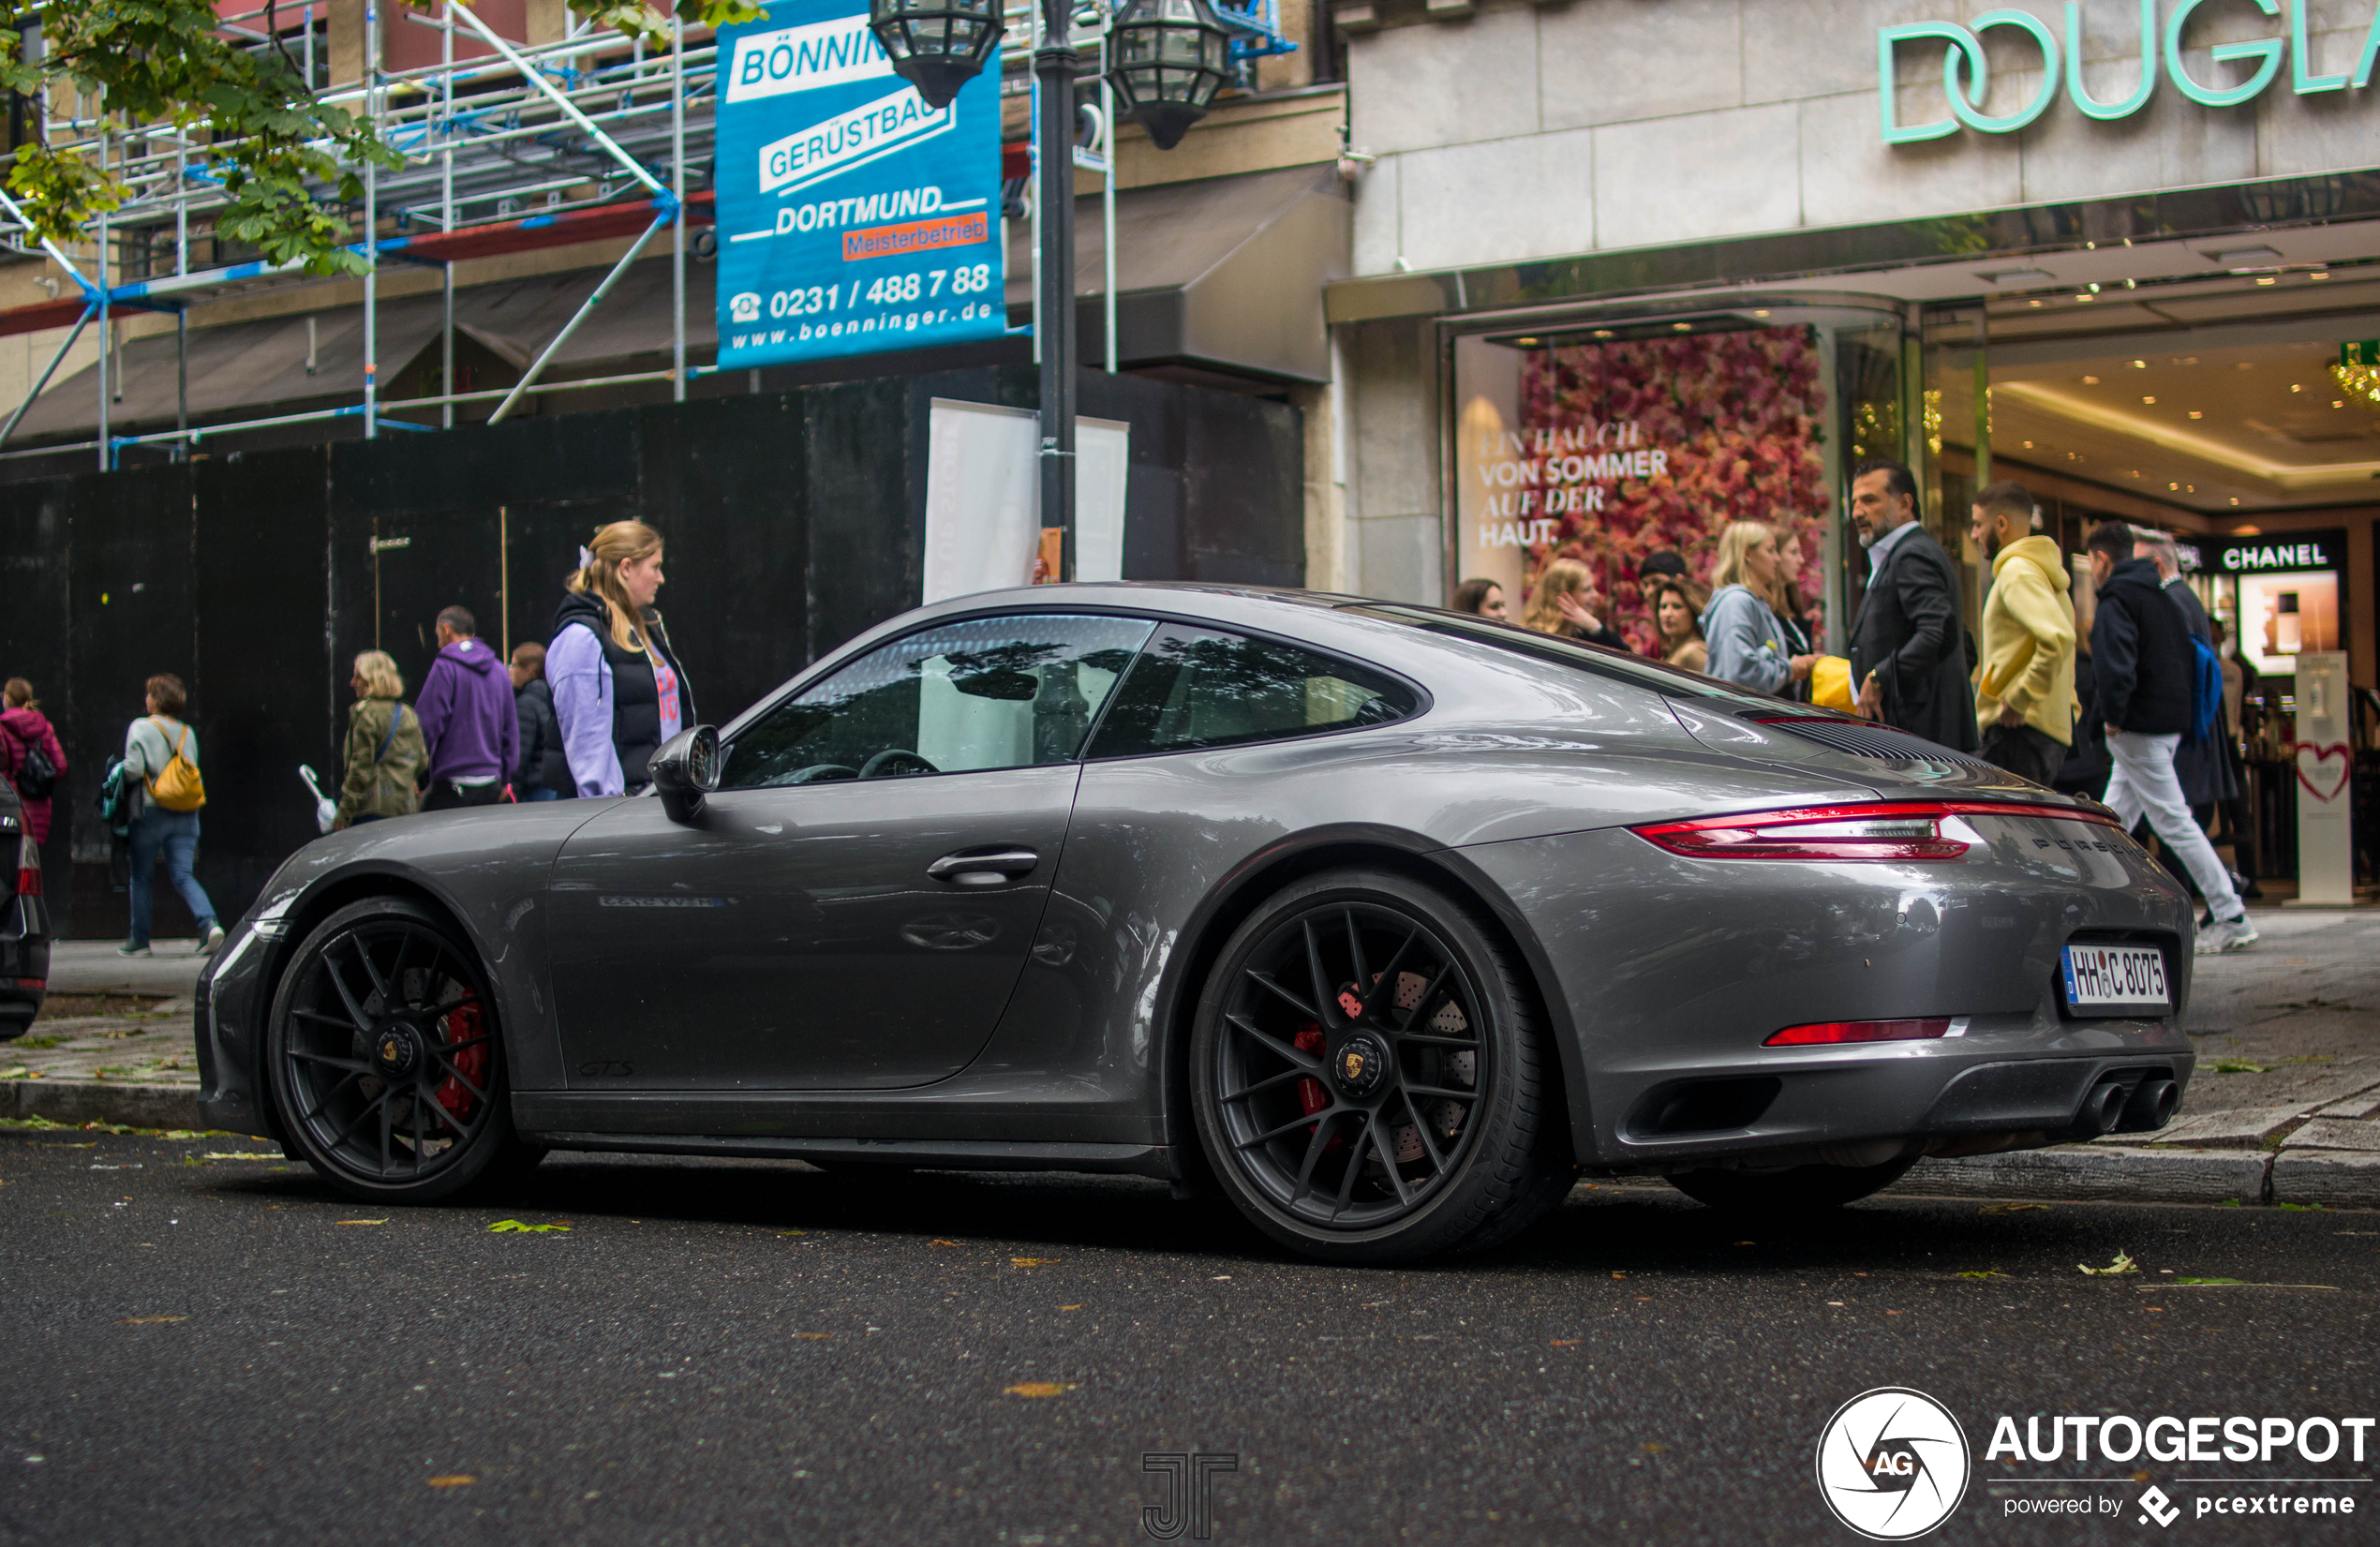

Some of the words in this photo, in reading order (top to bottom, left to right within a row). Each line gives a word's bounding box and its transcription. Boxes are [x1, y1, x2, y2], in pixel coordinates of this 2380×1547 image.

[775, 186, 942, 235] DORTMUND
[847, 219, 985, 256] Meisterbetrieb
[769, 284, 840, 319] 0231
[866, 273, 921, 305] 488
[929, 270, 947, 297] 7
[951, 263, 990, 294] 88
[732, 302, 991, 350] www.boenninger.de
[1534, 421, 1640, 454] HAUCH
[1479, 459, 1540, 487] VON
[1545, 450, 1669, 483] SOMMER
[1480, 490, 1540, 519] AUF
[1544, 485, 1605, 514] DER
[1479, 518, 1559, 548] HAUT.
[2223, 543, 2328, 570] CHANEL
[2032, 839, 2149, 859] PORSCHE
[2072, 950, 2103, 997] HH
[2108, 952, 2123, 996] C
[2122, 952, 2164, 996] 8075
[580, 1060, 635, 1078] GTS
